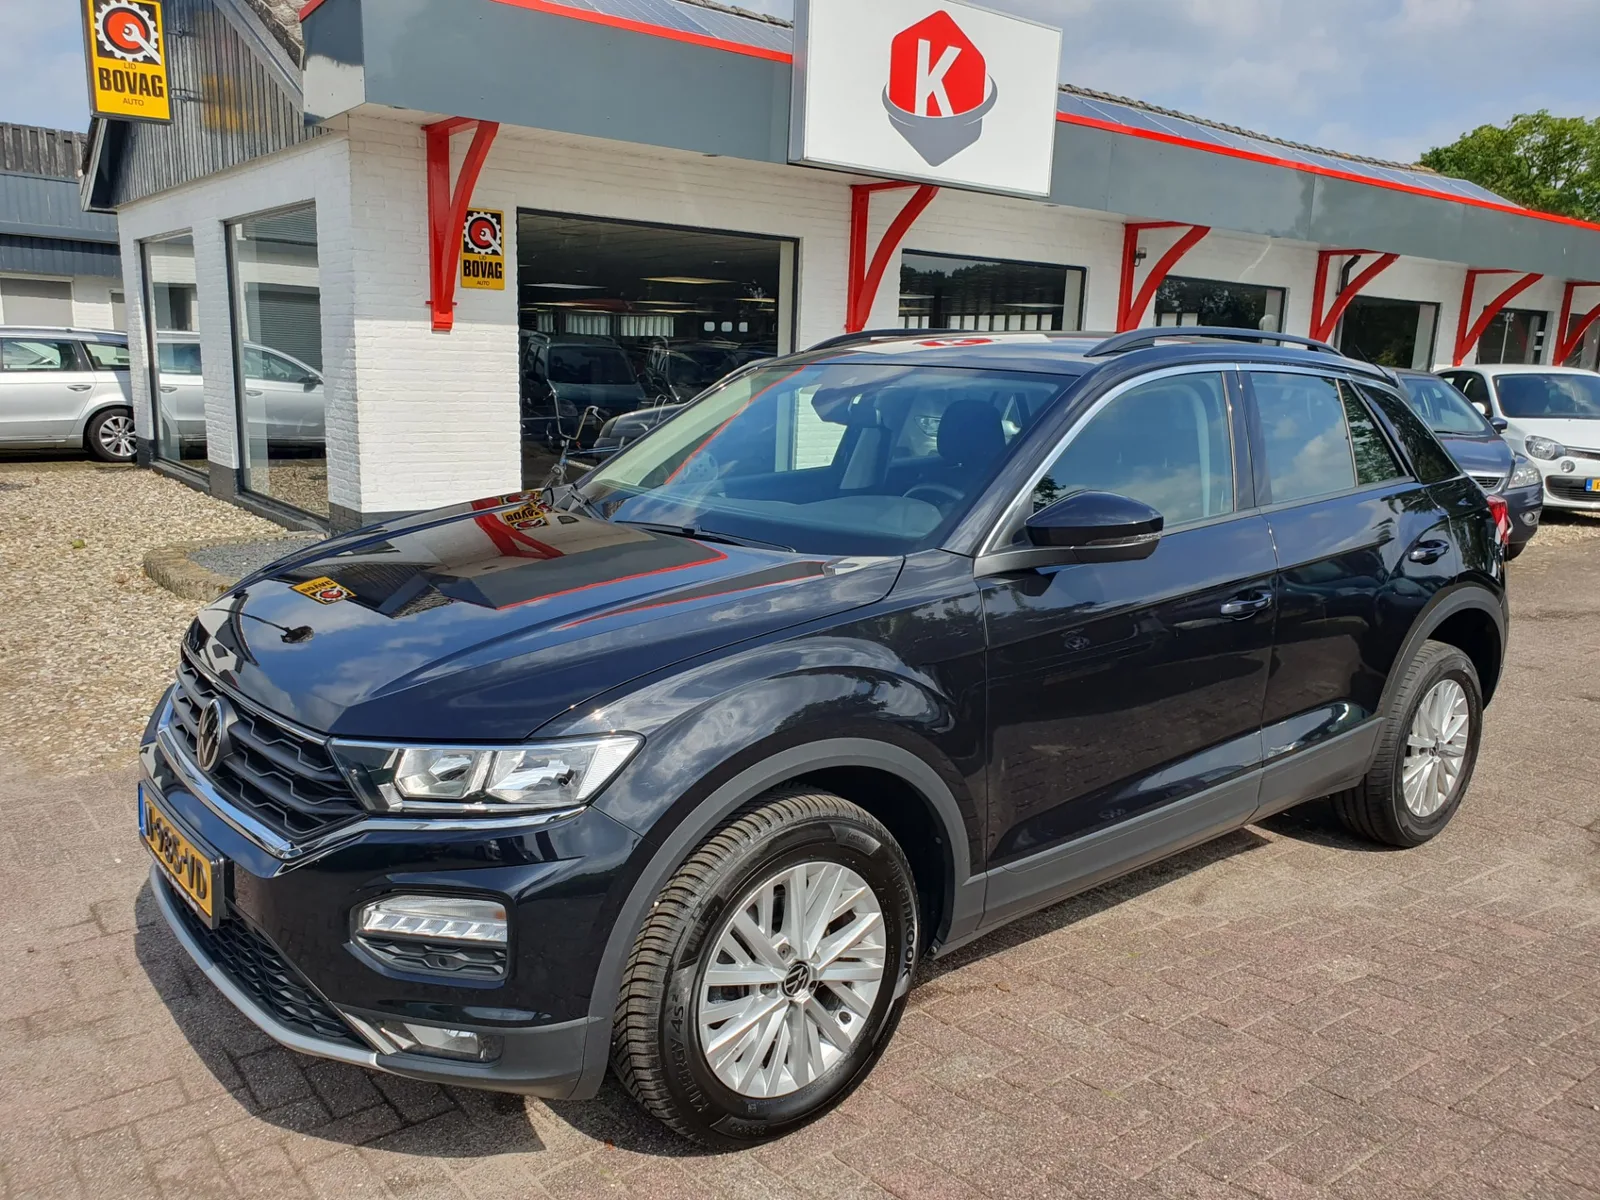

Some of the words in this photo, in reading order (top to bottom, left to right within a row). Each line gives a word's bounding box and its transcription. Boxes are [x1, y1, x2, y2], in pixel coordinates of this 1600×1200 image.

[123, 62, 137, 70] LID
[97, 66, 165, 98] BOVAG
[914, 38, 963, 117] K
[122, 97, 144, 107] AUTO
[463, 259, 503, 279] BOVAG
